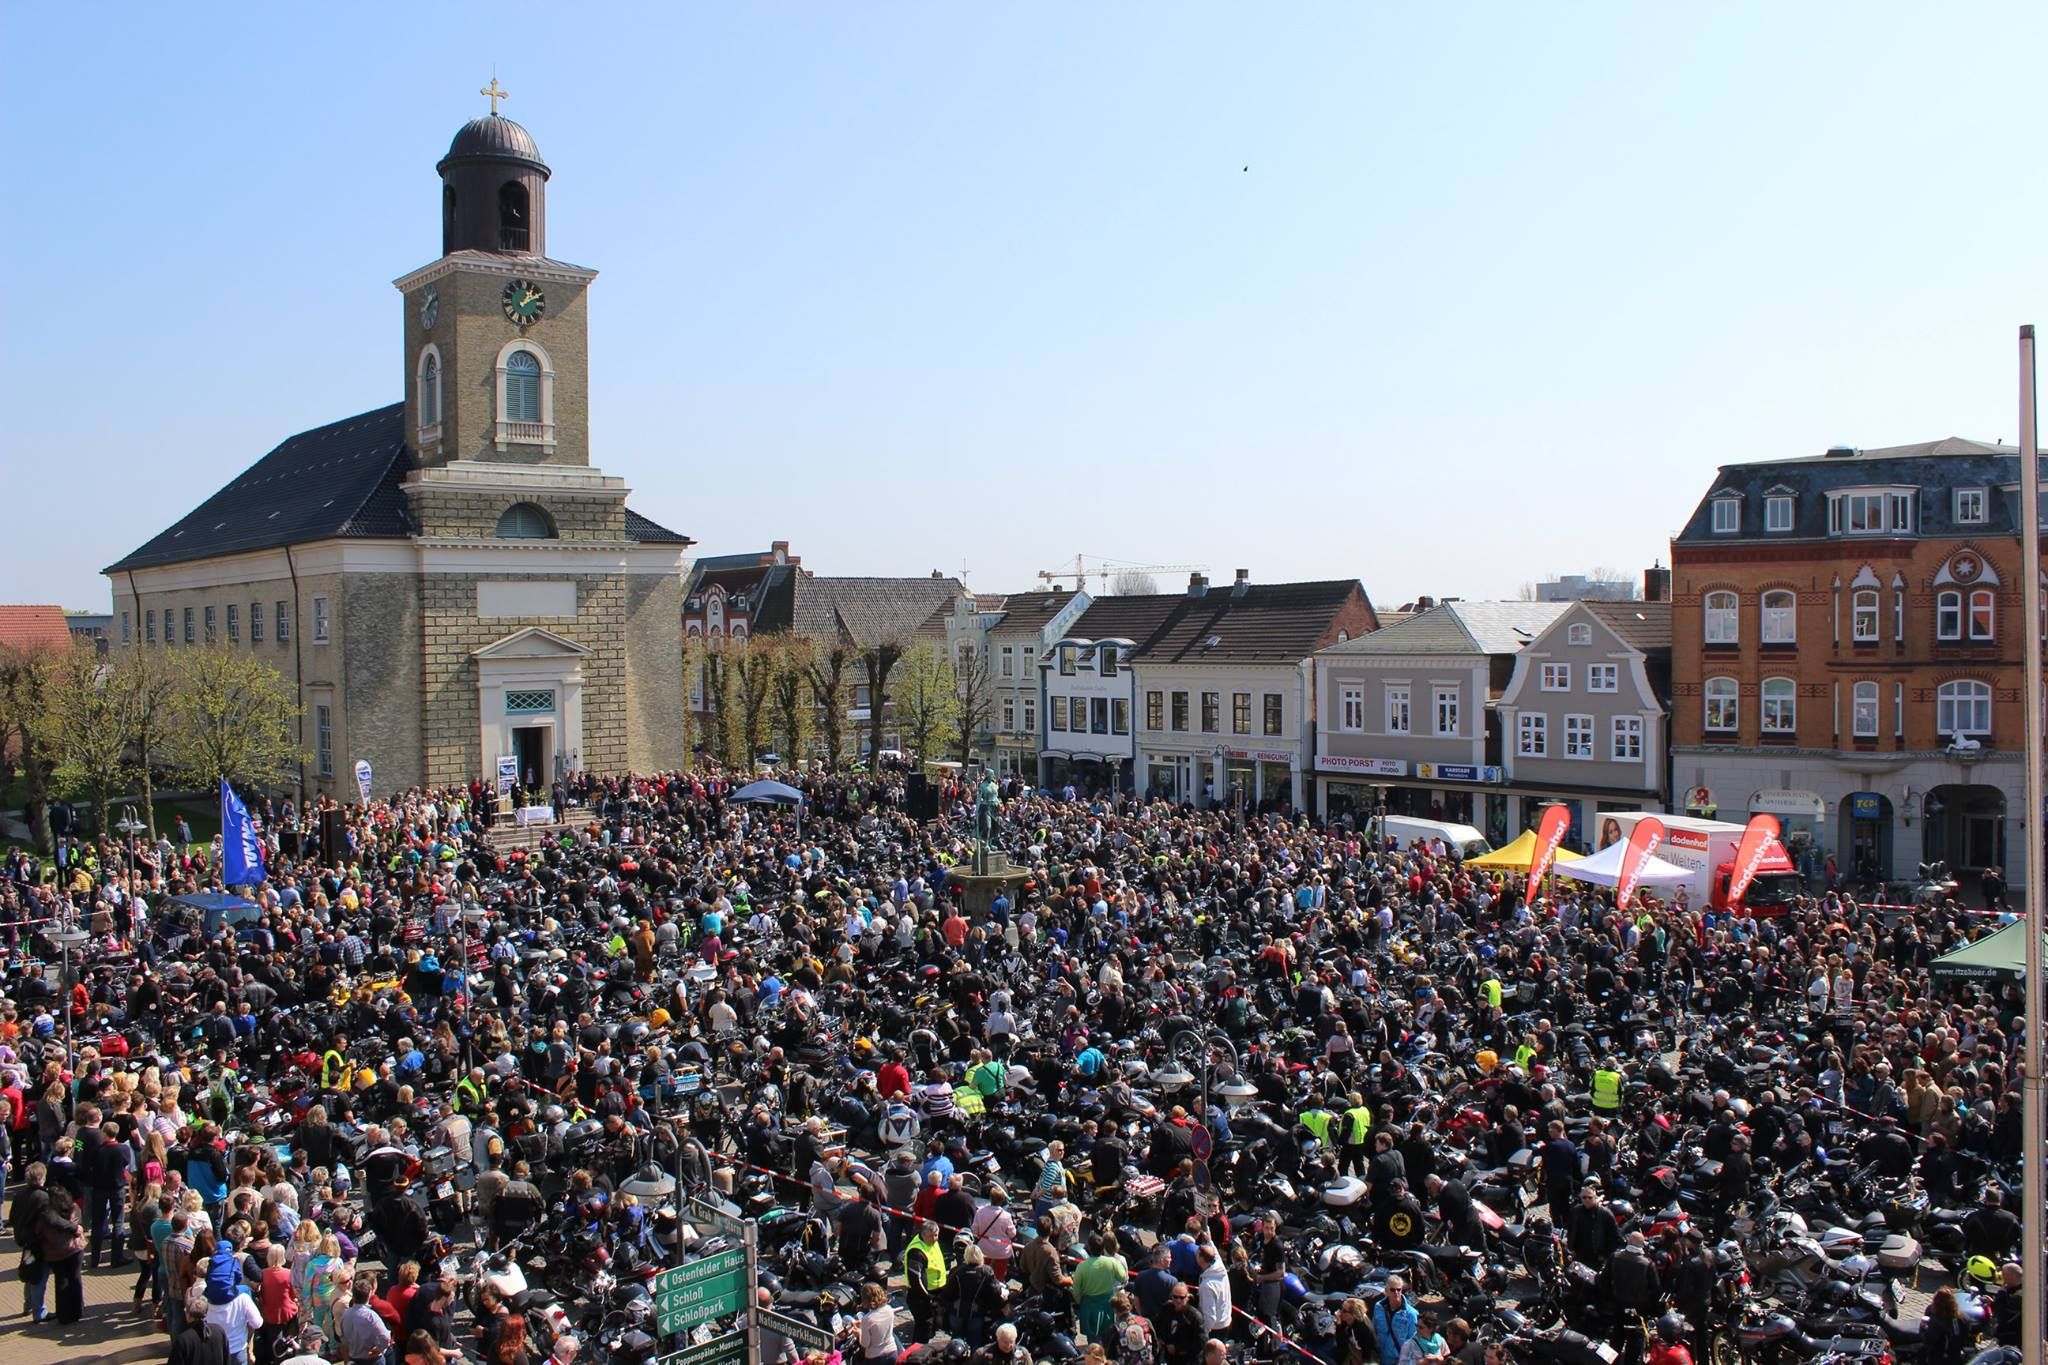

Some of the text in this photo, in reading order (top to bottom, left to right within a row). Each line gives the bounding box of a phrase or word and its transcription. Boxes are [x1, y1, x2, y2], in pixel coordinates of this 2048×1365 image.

[1321, 757, 1374, 767] PHOTO PORST
[1532, 820, 1567, 886] dodenhof
[1671, 835, 1707, 848] dodenhof
[1621, 833, 1661, 903] dodenhof
[1732, 829, 1776, 898] dodenhof
[672, 1254, 745, 1284] Ostenfelder Haus
[673, 1286, 703, 1306] Schloß
[674, 1300, 725, 1326] Schloßpark
[758, 1312, 822, 1346] NationalparkHaus
